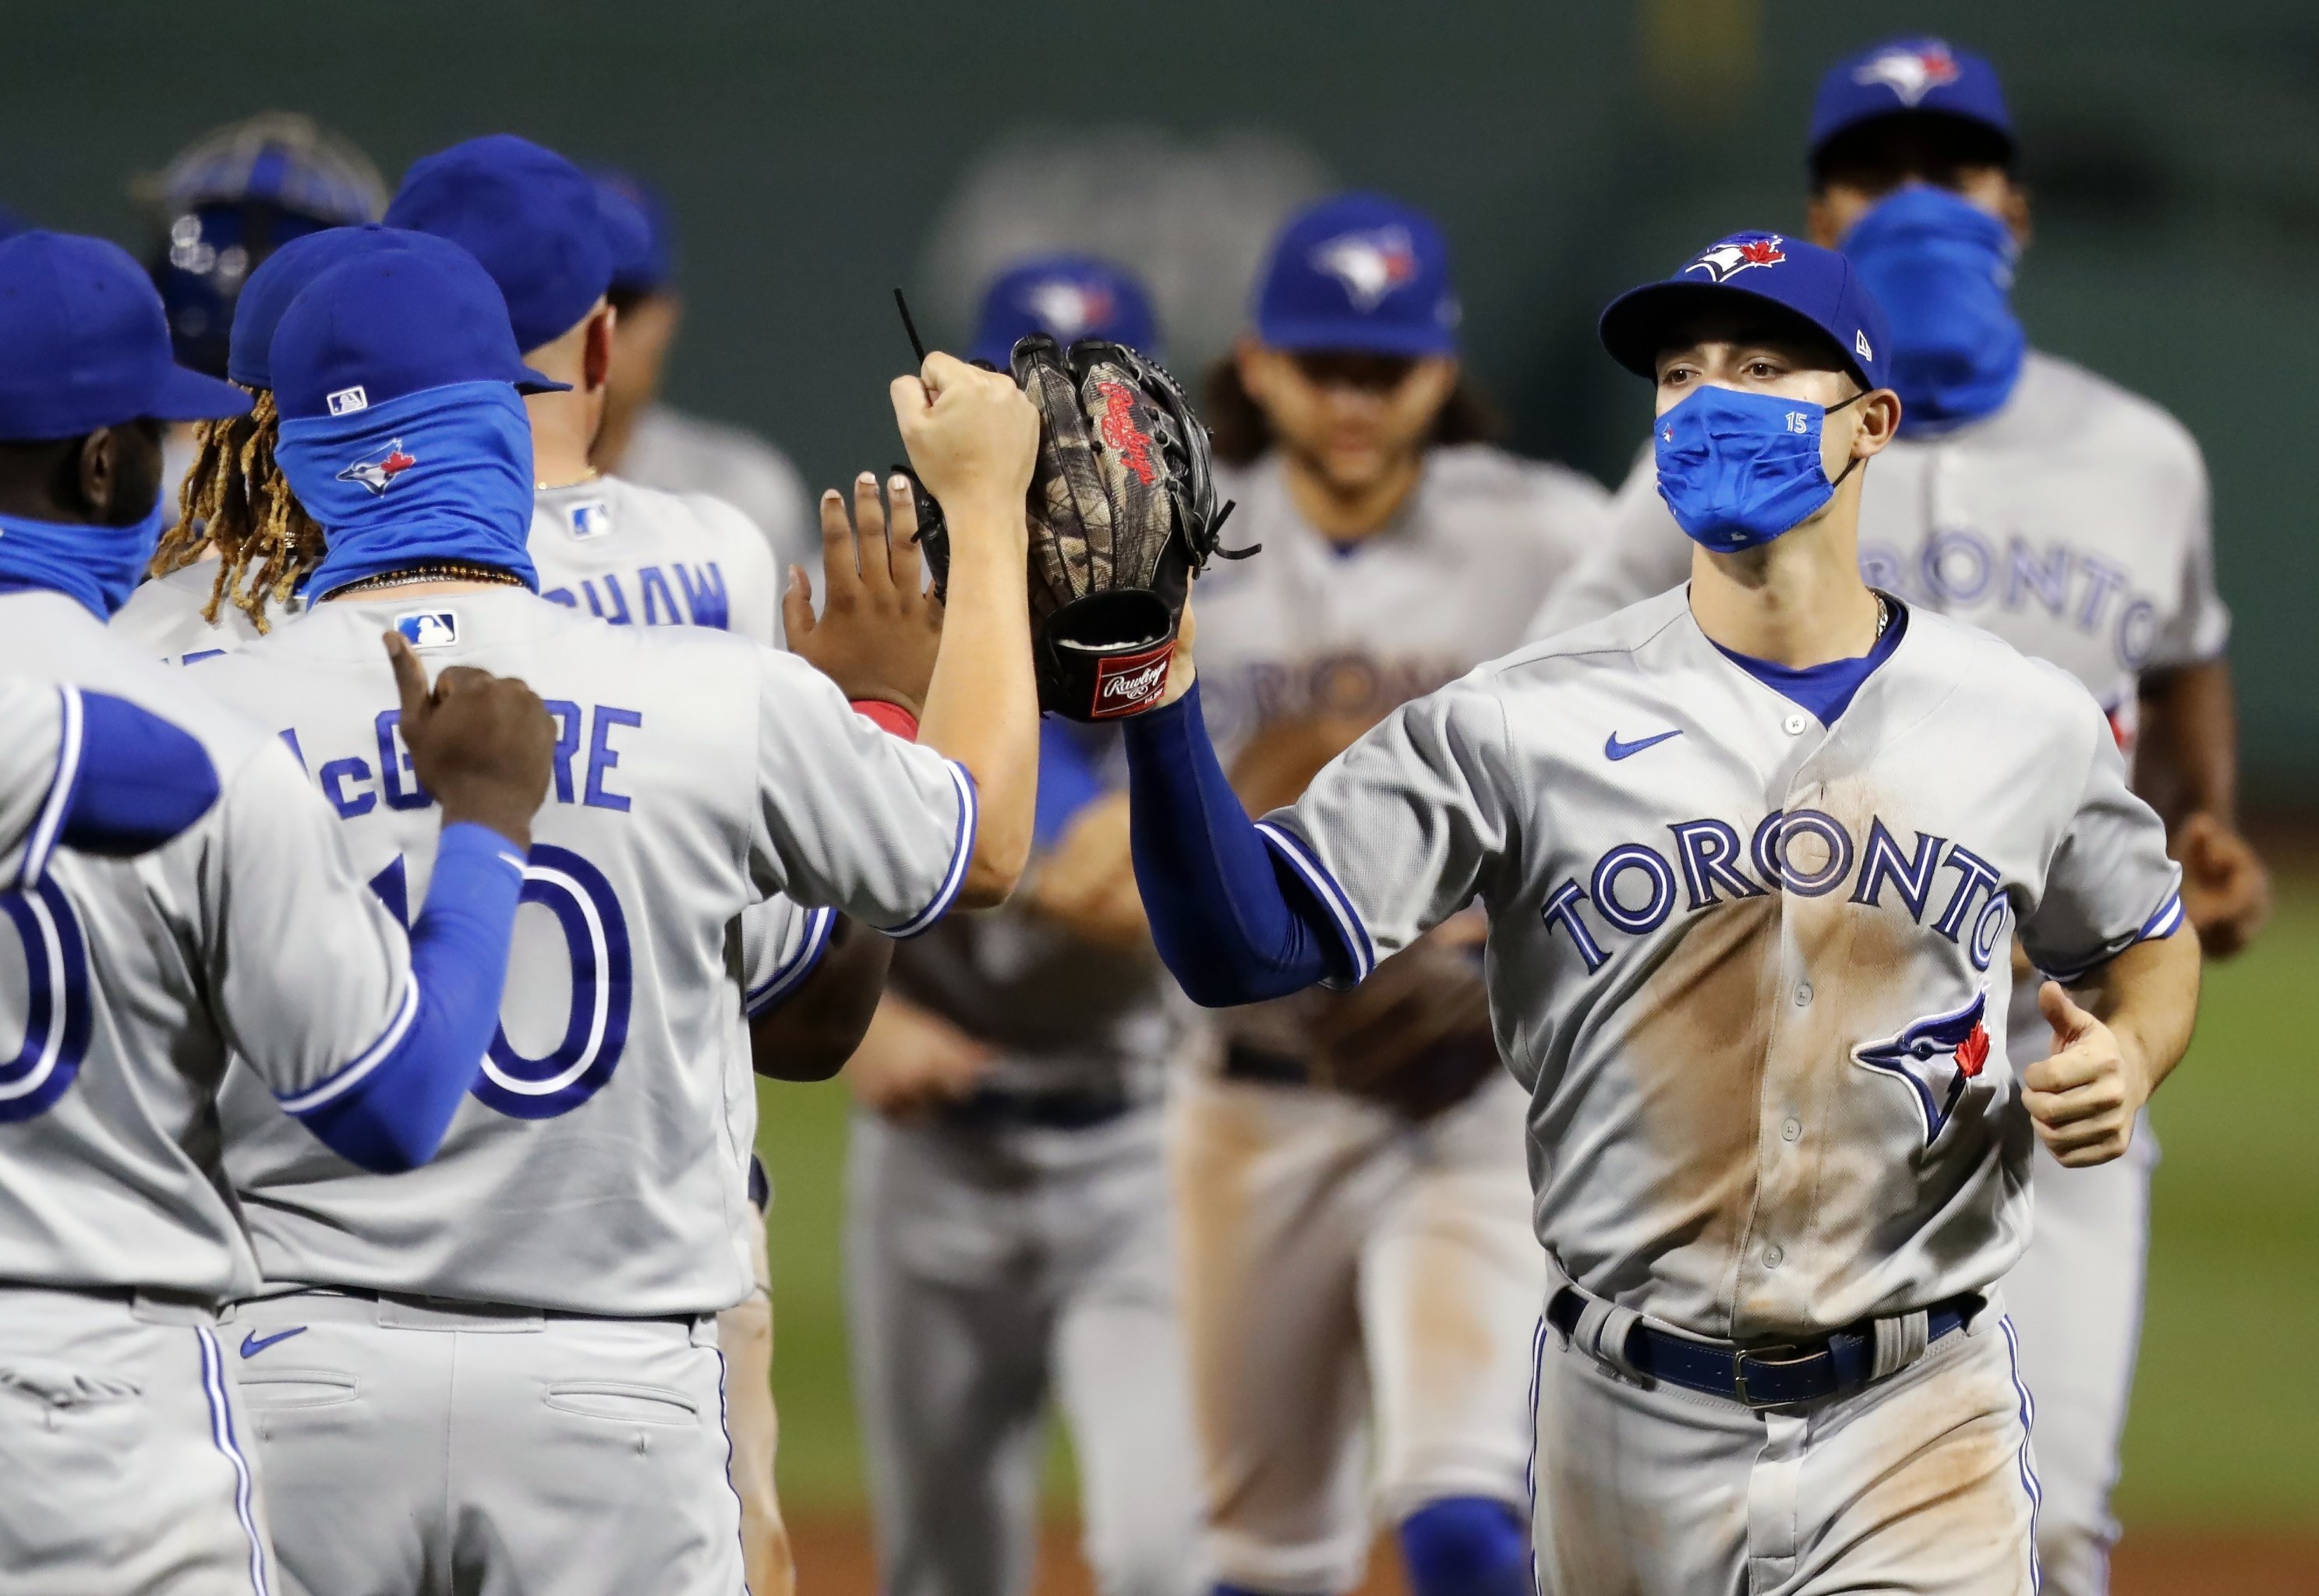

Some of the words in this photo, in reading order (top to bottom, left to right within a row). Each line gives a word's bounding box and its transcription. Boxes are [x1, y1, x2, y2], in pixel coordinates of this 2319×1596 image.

[1785, 411, 1808, 434] 15
[542, 561, 729, 630] HAW
[278, 699, 642, 820] cGRE
[1540, 808, 2016, 976] TORONTO
[368, 842, 632, 1120] 0
